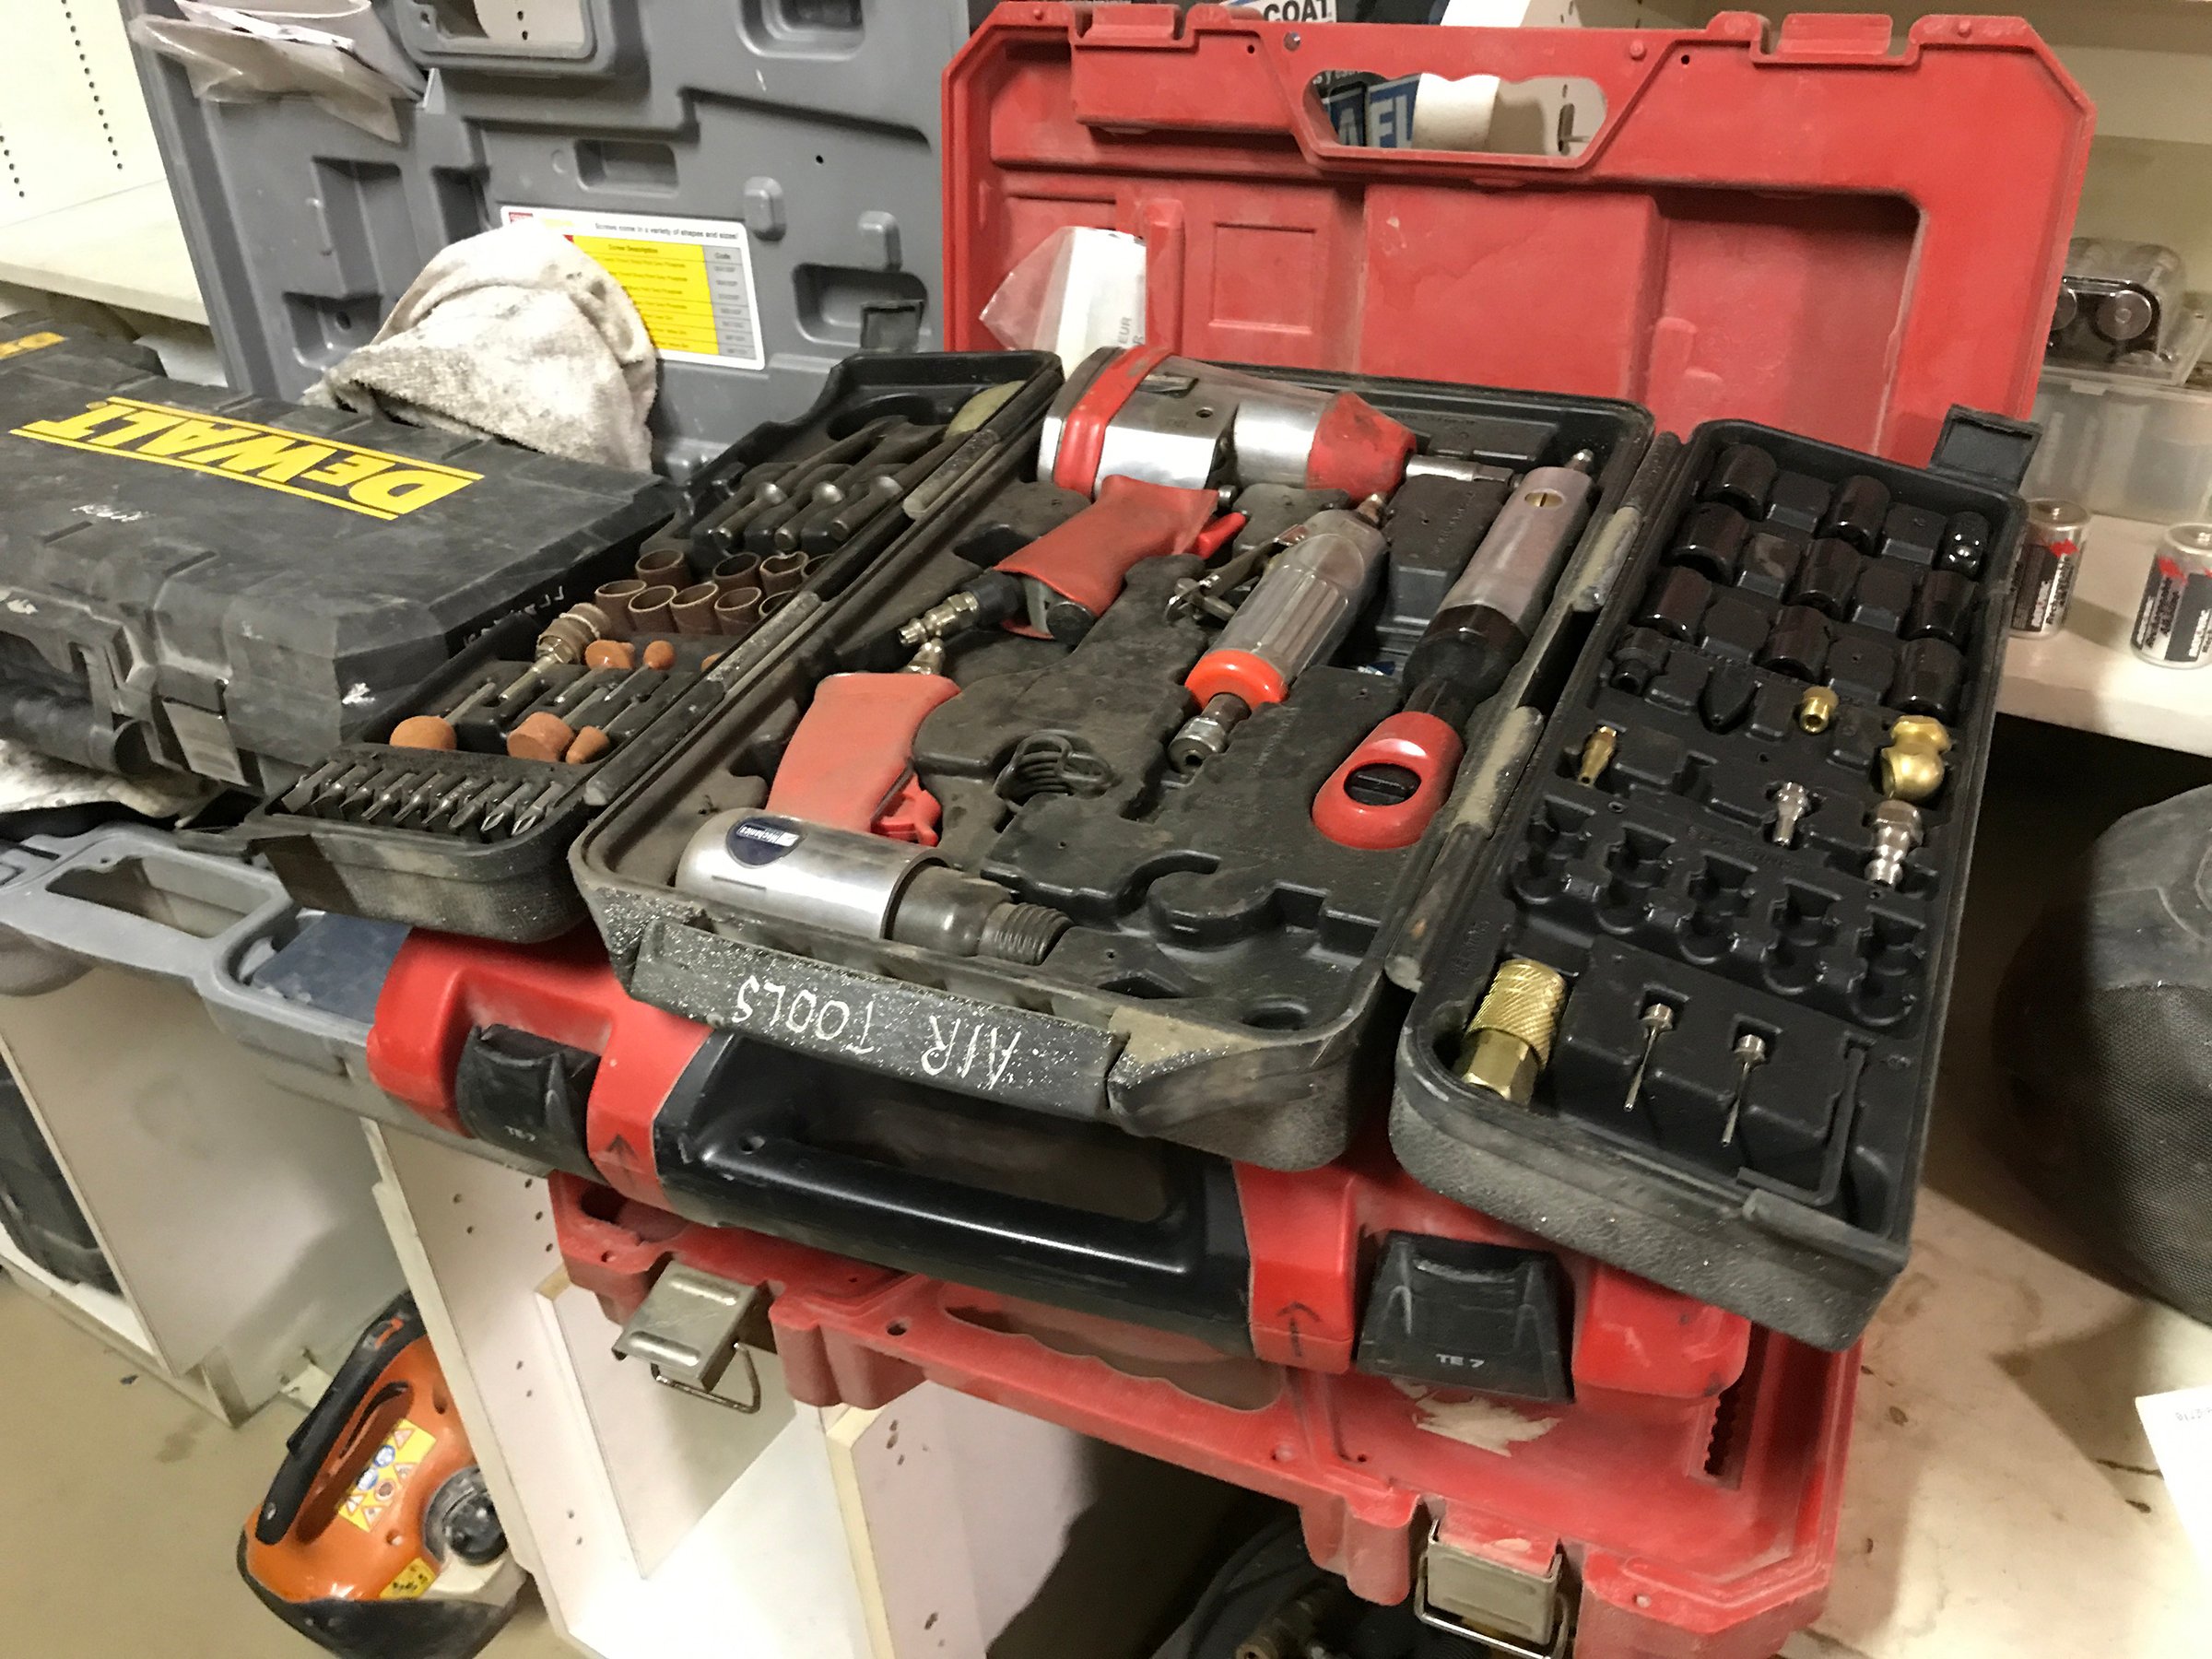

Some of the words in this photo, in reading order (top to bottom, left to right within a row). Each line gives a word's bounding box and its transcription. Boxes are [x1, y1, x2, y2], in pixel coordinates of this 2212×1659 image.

[651, 228, 671, 236] variety
[681, 229, 703, 238] shapes
[20, 403, 473, 514] DEWALT
[732, 975, 875, 1054] TOOLS
[921, 1016, 1021, 1090] AIR
[1436, 1353, 1464, 1367] TE
[1469, 1359, 1486, 1368] 7
